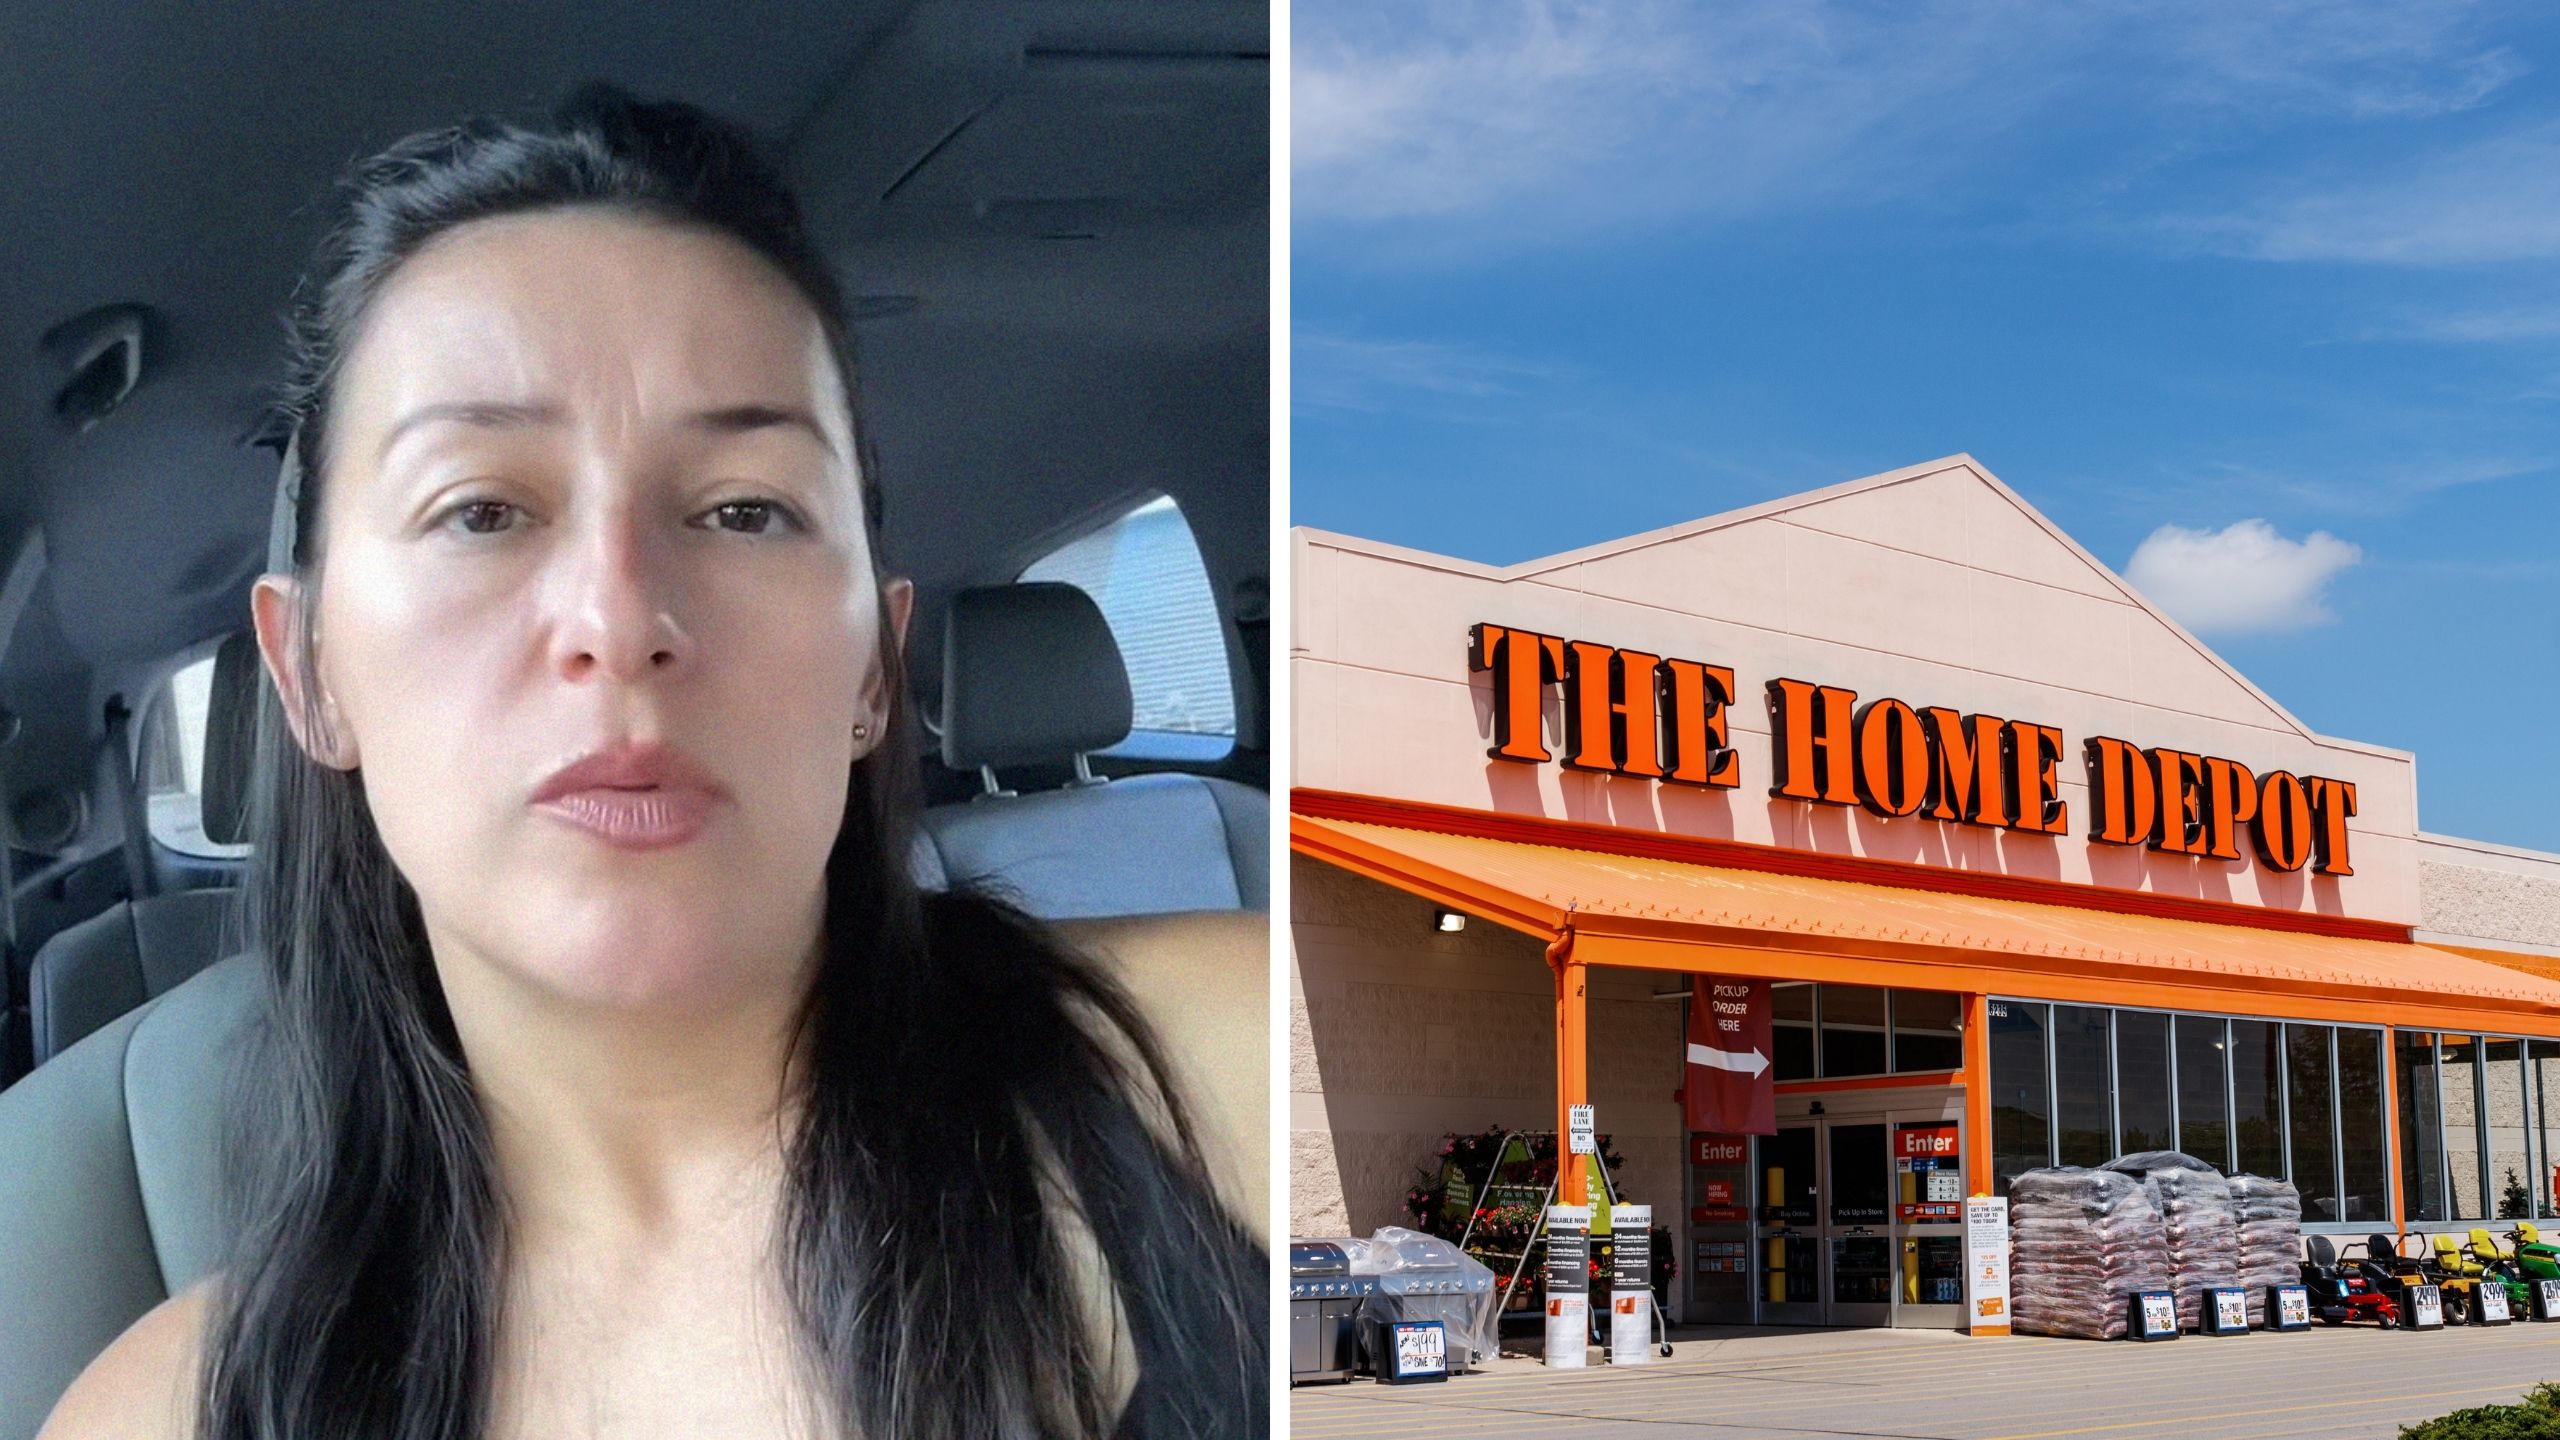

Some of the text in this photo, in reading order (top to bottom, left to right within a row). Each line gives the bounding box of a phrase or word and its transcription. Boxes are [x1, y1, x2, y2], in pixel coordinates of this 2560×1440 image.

[1468, 622, 2357, 877] THE HOME DEPOT
[1713, 985, 1749, 997] PICKUP
[1712, 1001, 1748, 1015] ORDER
[1717, 1019, 1741, 1032] HERE
[1905, 1133, 1953, 1152] Enter
[1701, 1142, 1743, 1160] Enter
[1851, 1209, 1860, 1217] Up
[2220, 1303, 2225, 1313] 5
[2282, 1300, 2288, 1310] 5
[2146, 1307, 2152, 1317] 5
